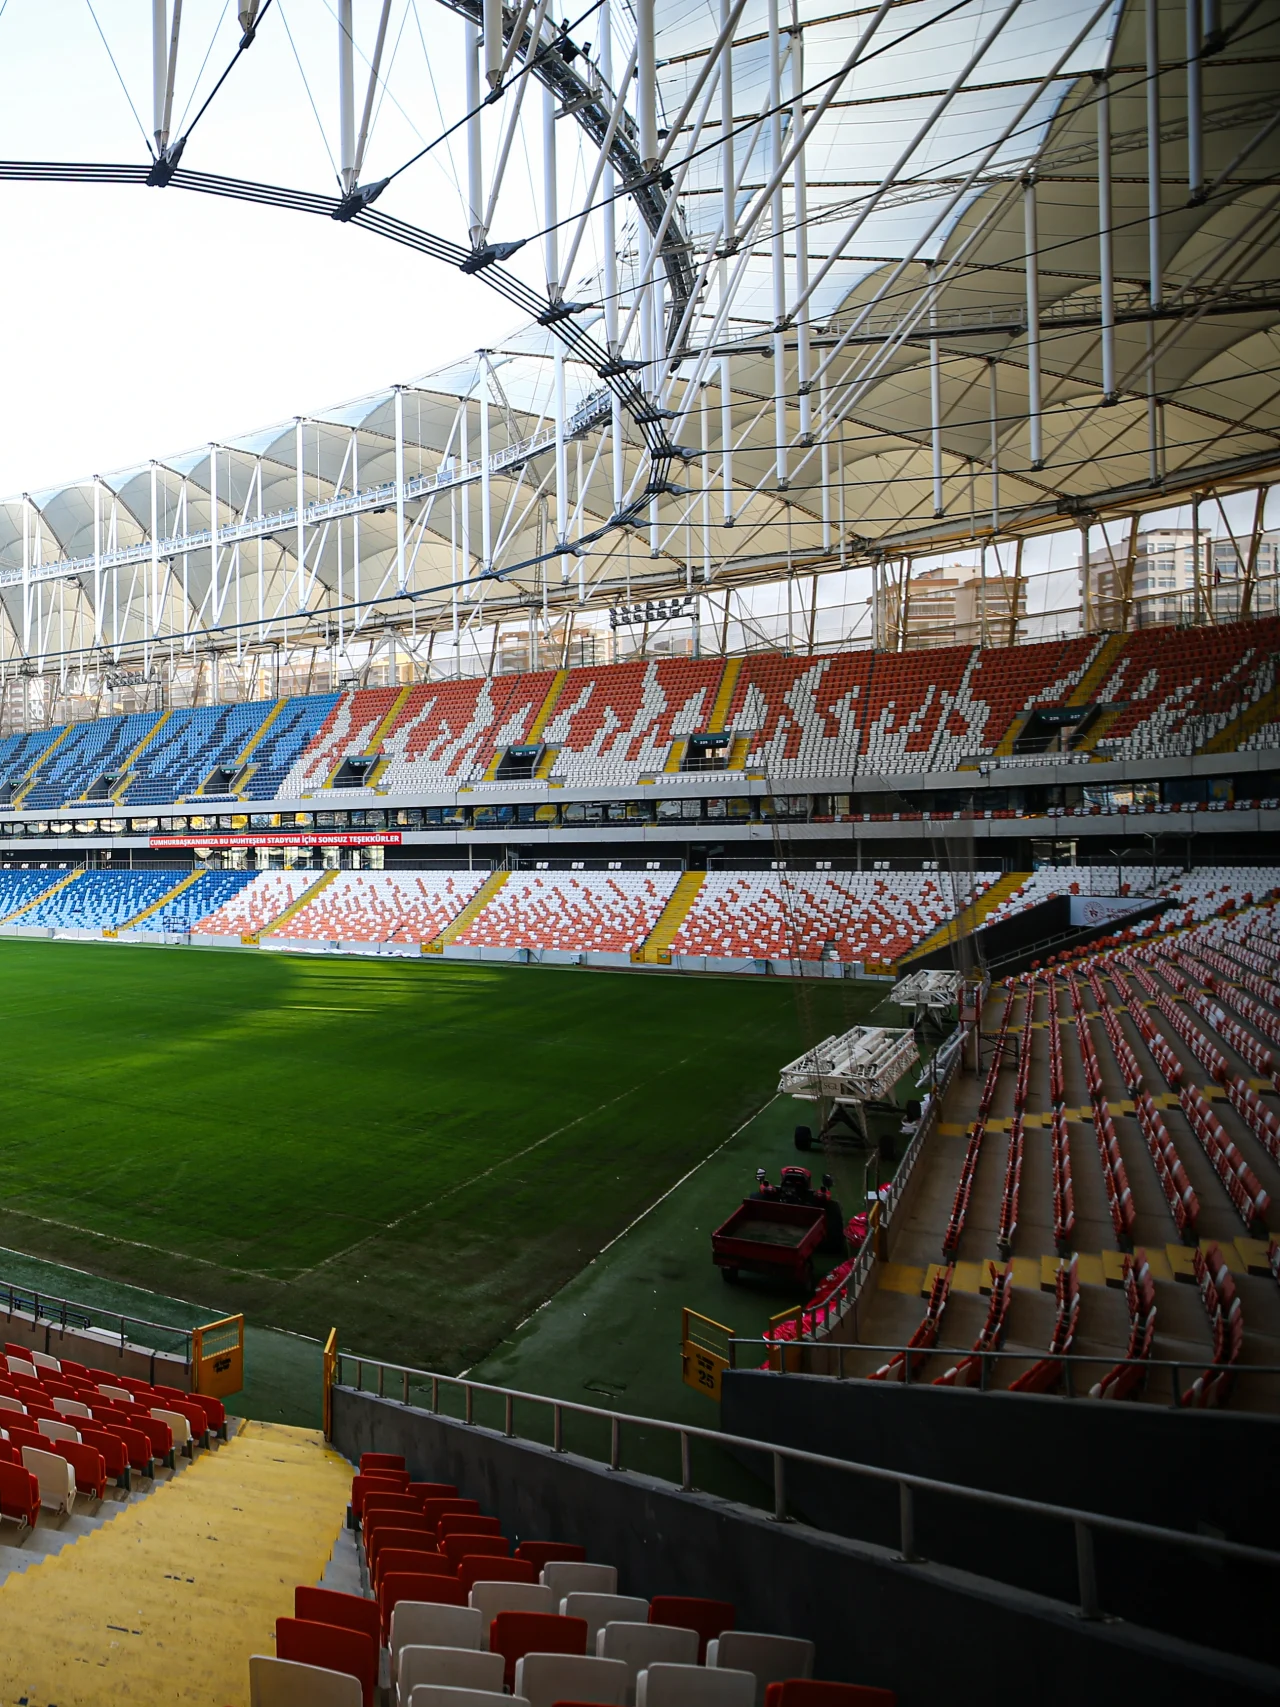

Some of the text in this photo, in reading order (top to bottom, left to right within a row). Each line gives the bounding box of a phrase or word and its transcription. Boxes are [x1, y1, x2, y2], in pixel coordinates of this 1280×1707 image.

[149, 838, 218, 847] CUMHURBAŞKANIMIZA
[230, 837, 266, 846] MUHTEŞEM
[267, 836, 300, 844] STADYUM
[301, 835, 317, 845] İÇİN
[349, 834, 400, 845] TEŞEKKÜRLER
[698, 1369, 715, 1389] 25
